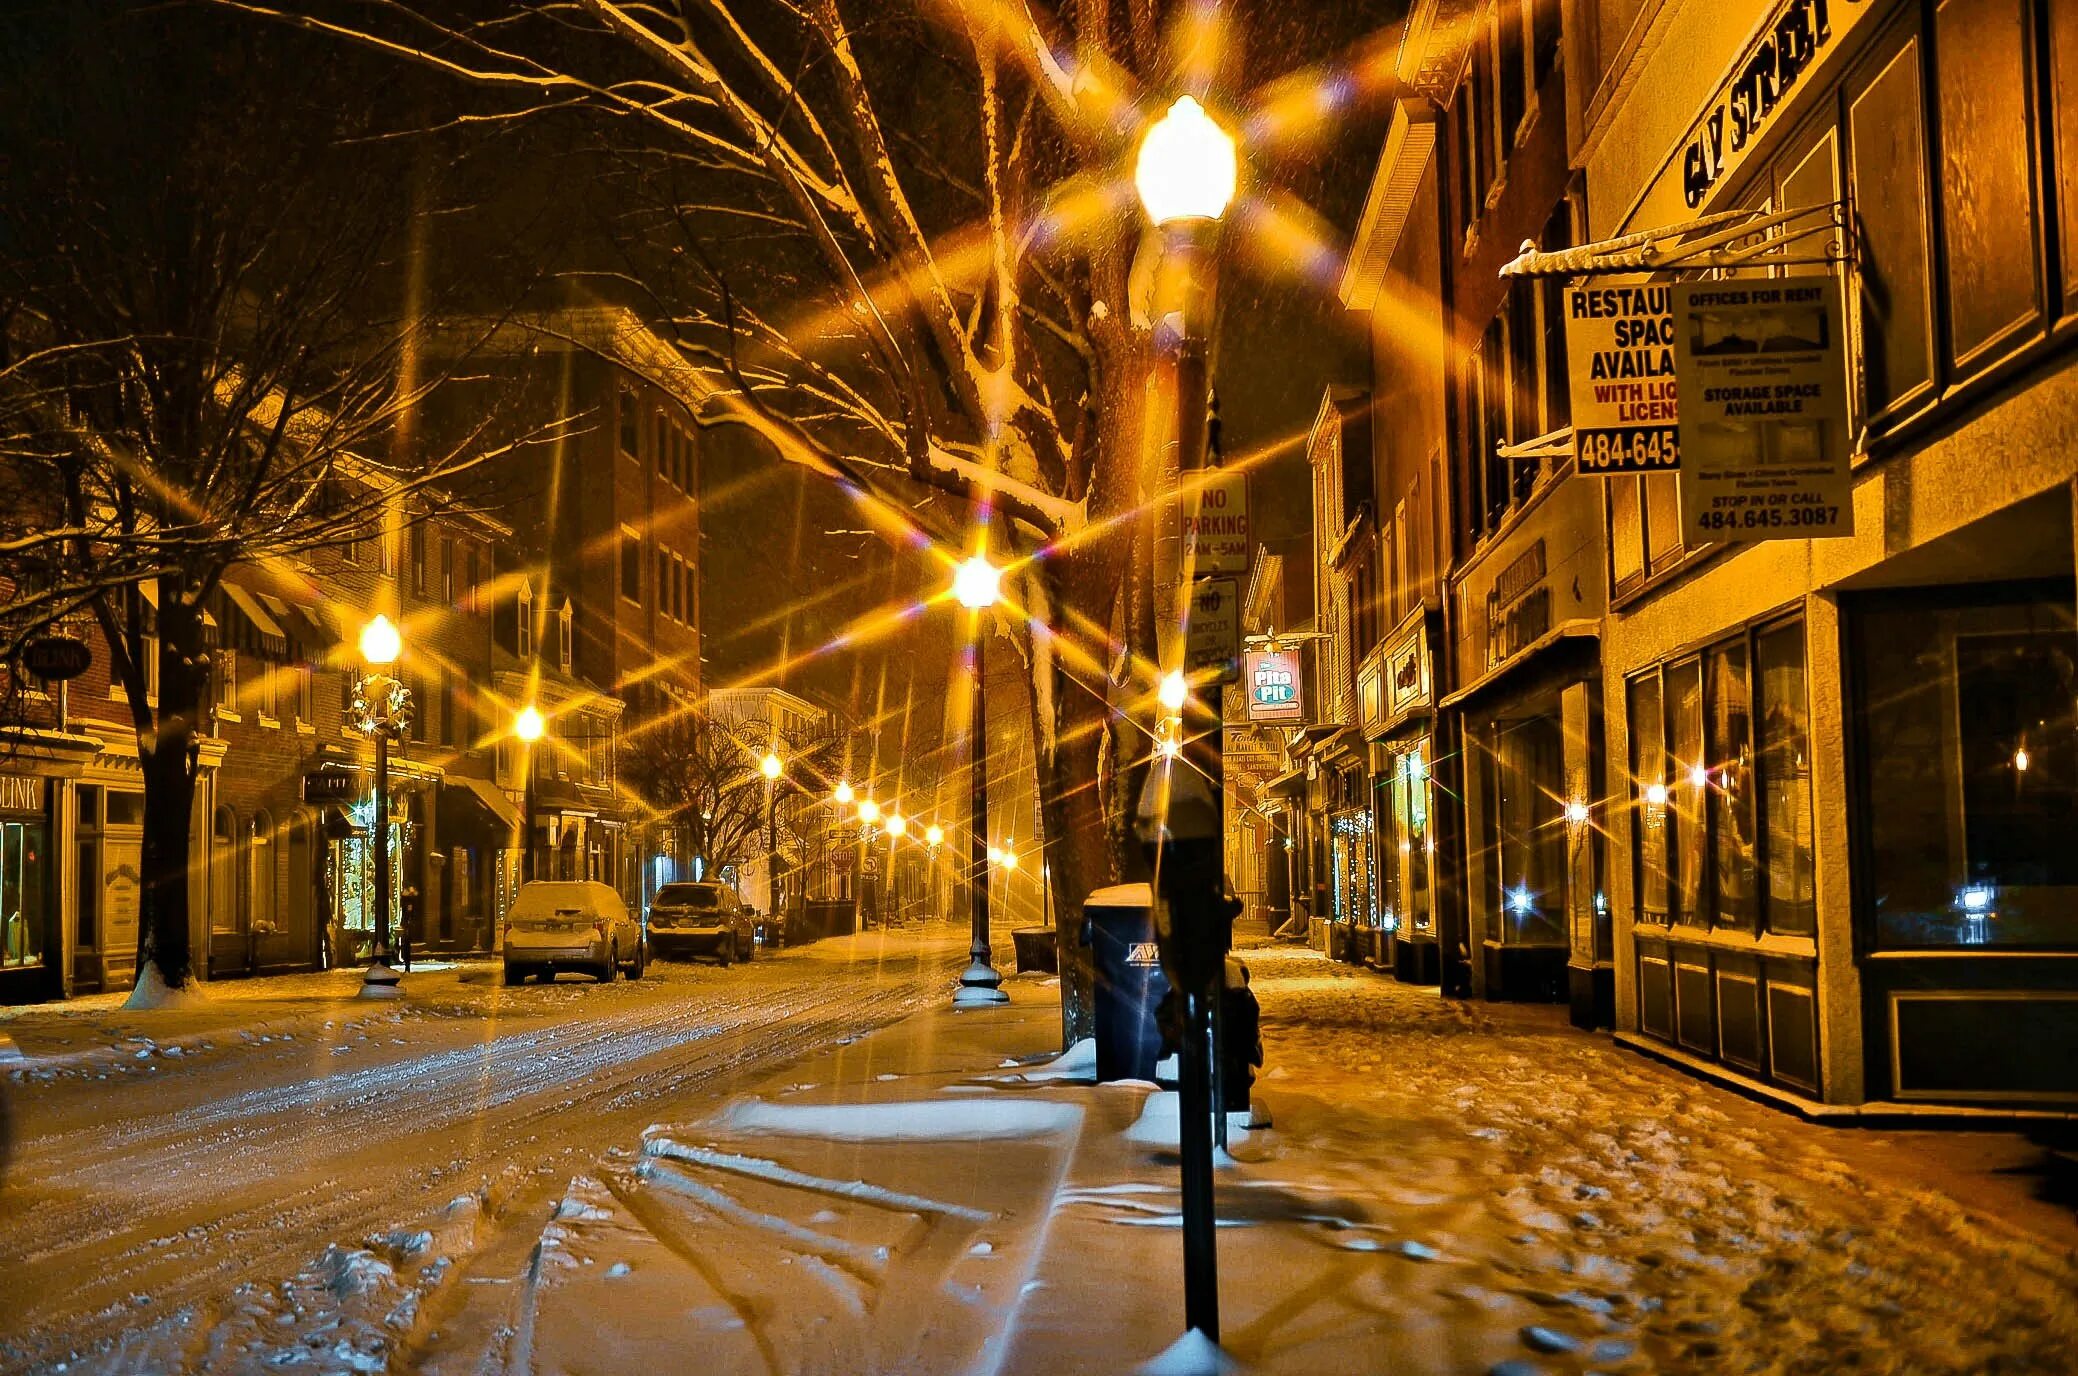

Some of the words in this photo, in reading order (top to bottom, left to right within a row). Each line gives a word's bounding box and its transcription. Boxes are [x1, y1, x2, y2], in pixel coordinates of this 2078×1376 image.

[1688, 290, 1748, 307] OFFICES
[1751, 289, 1781, 304] FOR
[1783, 287, 1823, 302] RENT
[1614, 317, 1674, 348] SPAC
[1590, 349, 1676, 380] AVAILA
[1594, 383, 1642, 403] WITH
[1704, 384, 1772, 403] STORAGE
[1775, 383, 1822, 399] SPACE
[1725, 400, 1803, 417] AVAILABLE
[1202, 489, 1227, 509] NO
[1712, 496, 1748, 509] STOP
[1750, 495, 1765, 506] IN
[1768, 493, 1788, 504] OR
[1791, 492, 1825, 505] CALL
[1184, 515, 1246, 535] PARKING
[1699, 505, 1839, 529] 484.645.3087
[0, 776, 37, 810] LINK
[832, 851, 854, 861] STOP
